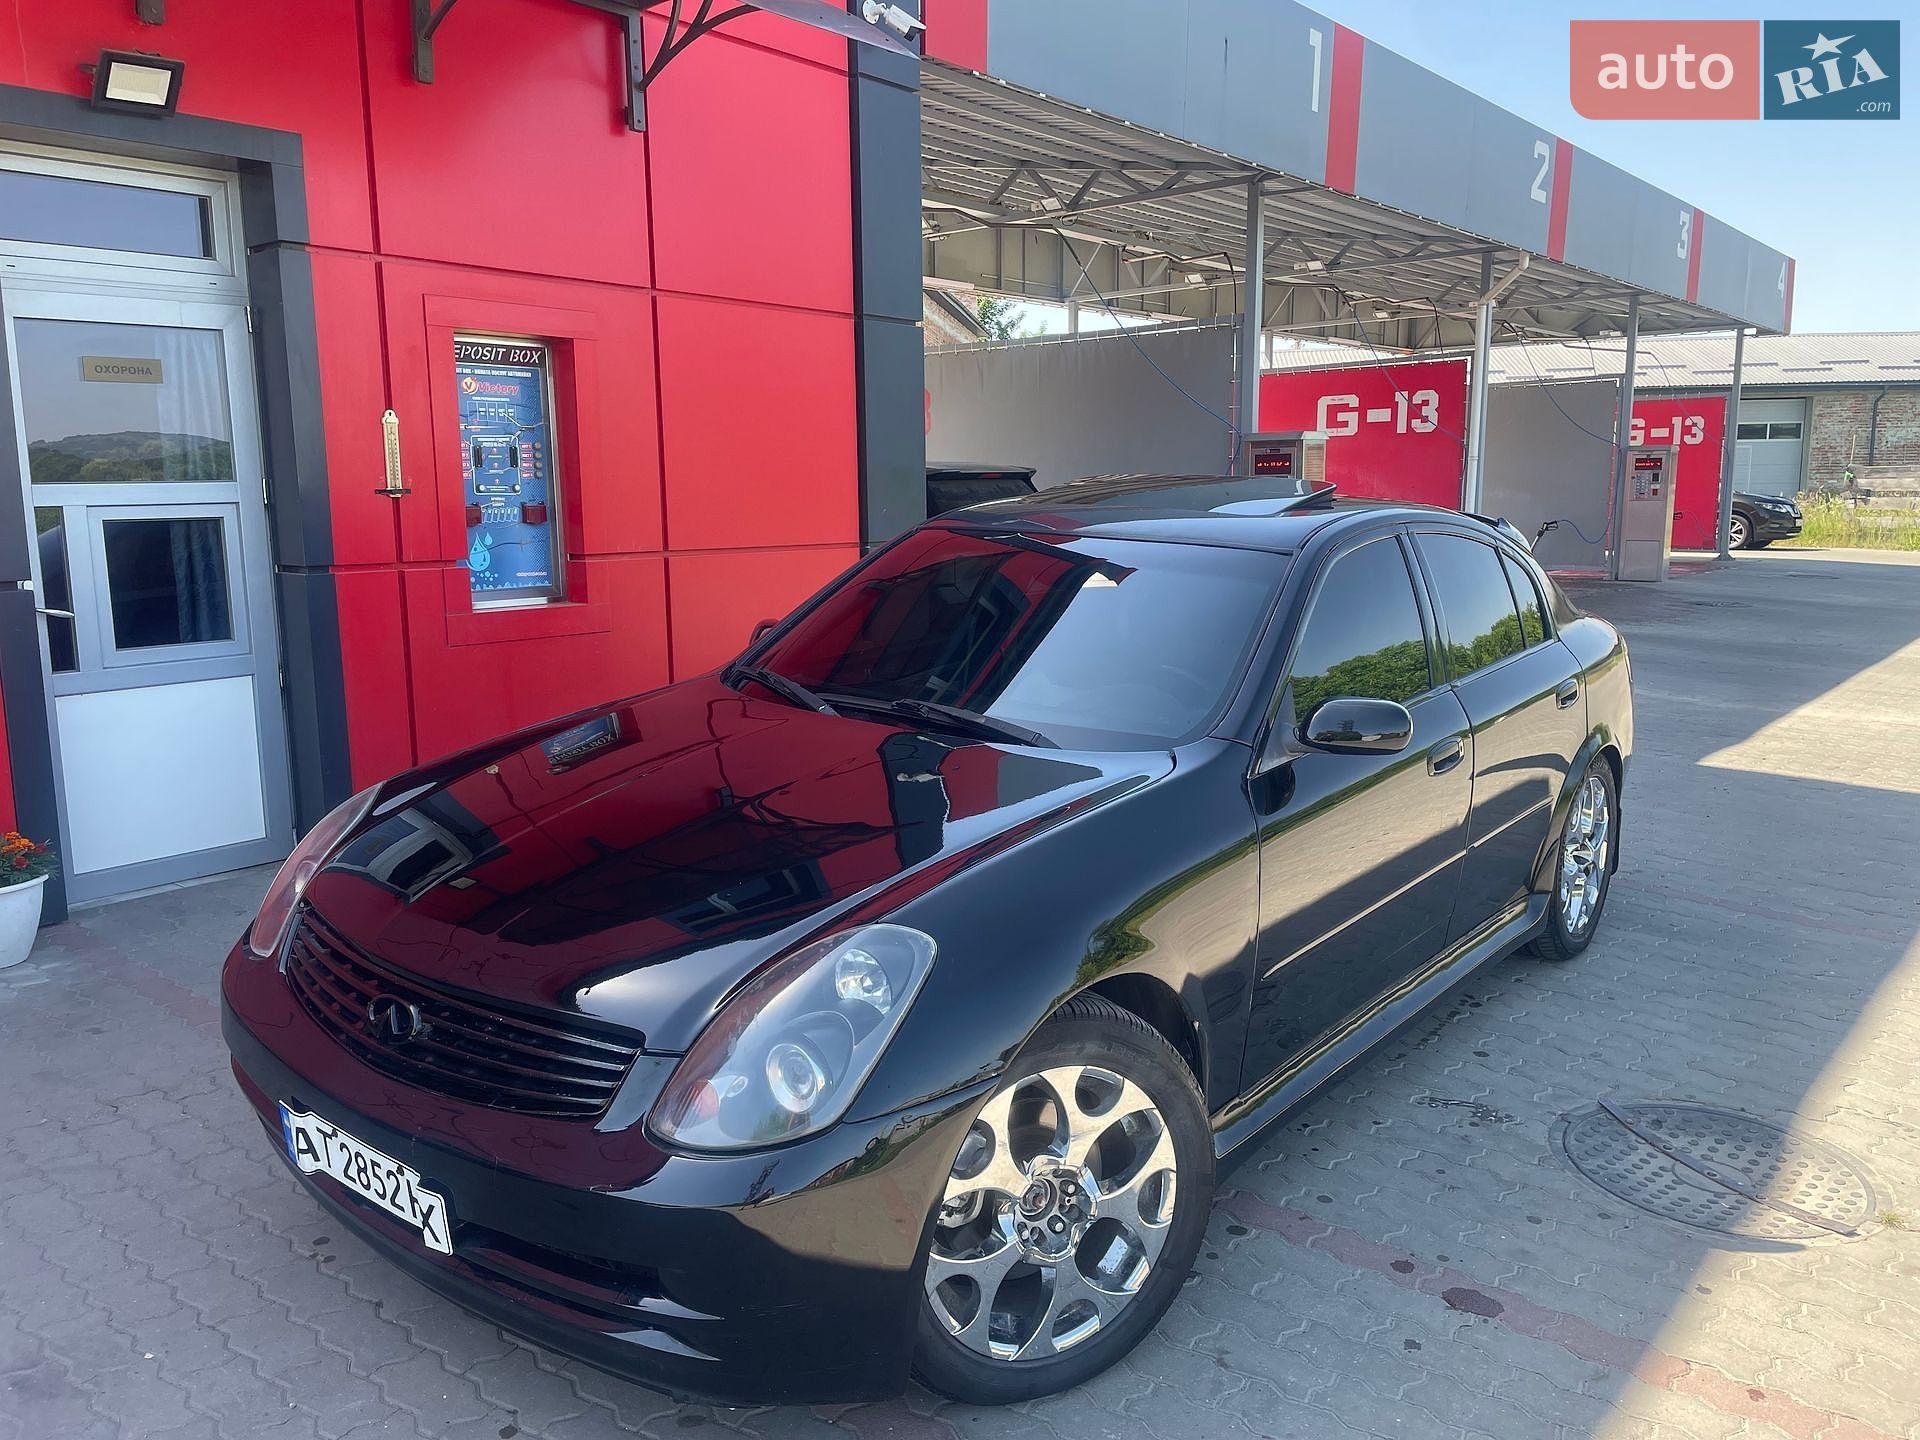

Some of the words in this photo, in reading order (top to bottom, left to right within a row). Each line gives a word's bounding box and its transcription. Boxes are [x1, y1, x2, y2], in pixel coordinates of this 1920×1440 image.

[1309, 28, 1322, 113] 1
[1530, 140, 1550, 204] 2
[1677, 210, 1689, 259] 3
[1778, 262, 1785, 299] 4
[94, 364, 152, 376] ОХОРОНА
[510, 349, 541, 363] BOX
[478, 381, 519, 395] Victory
[1317, 389, 1440, 437] G-13
